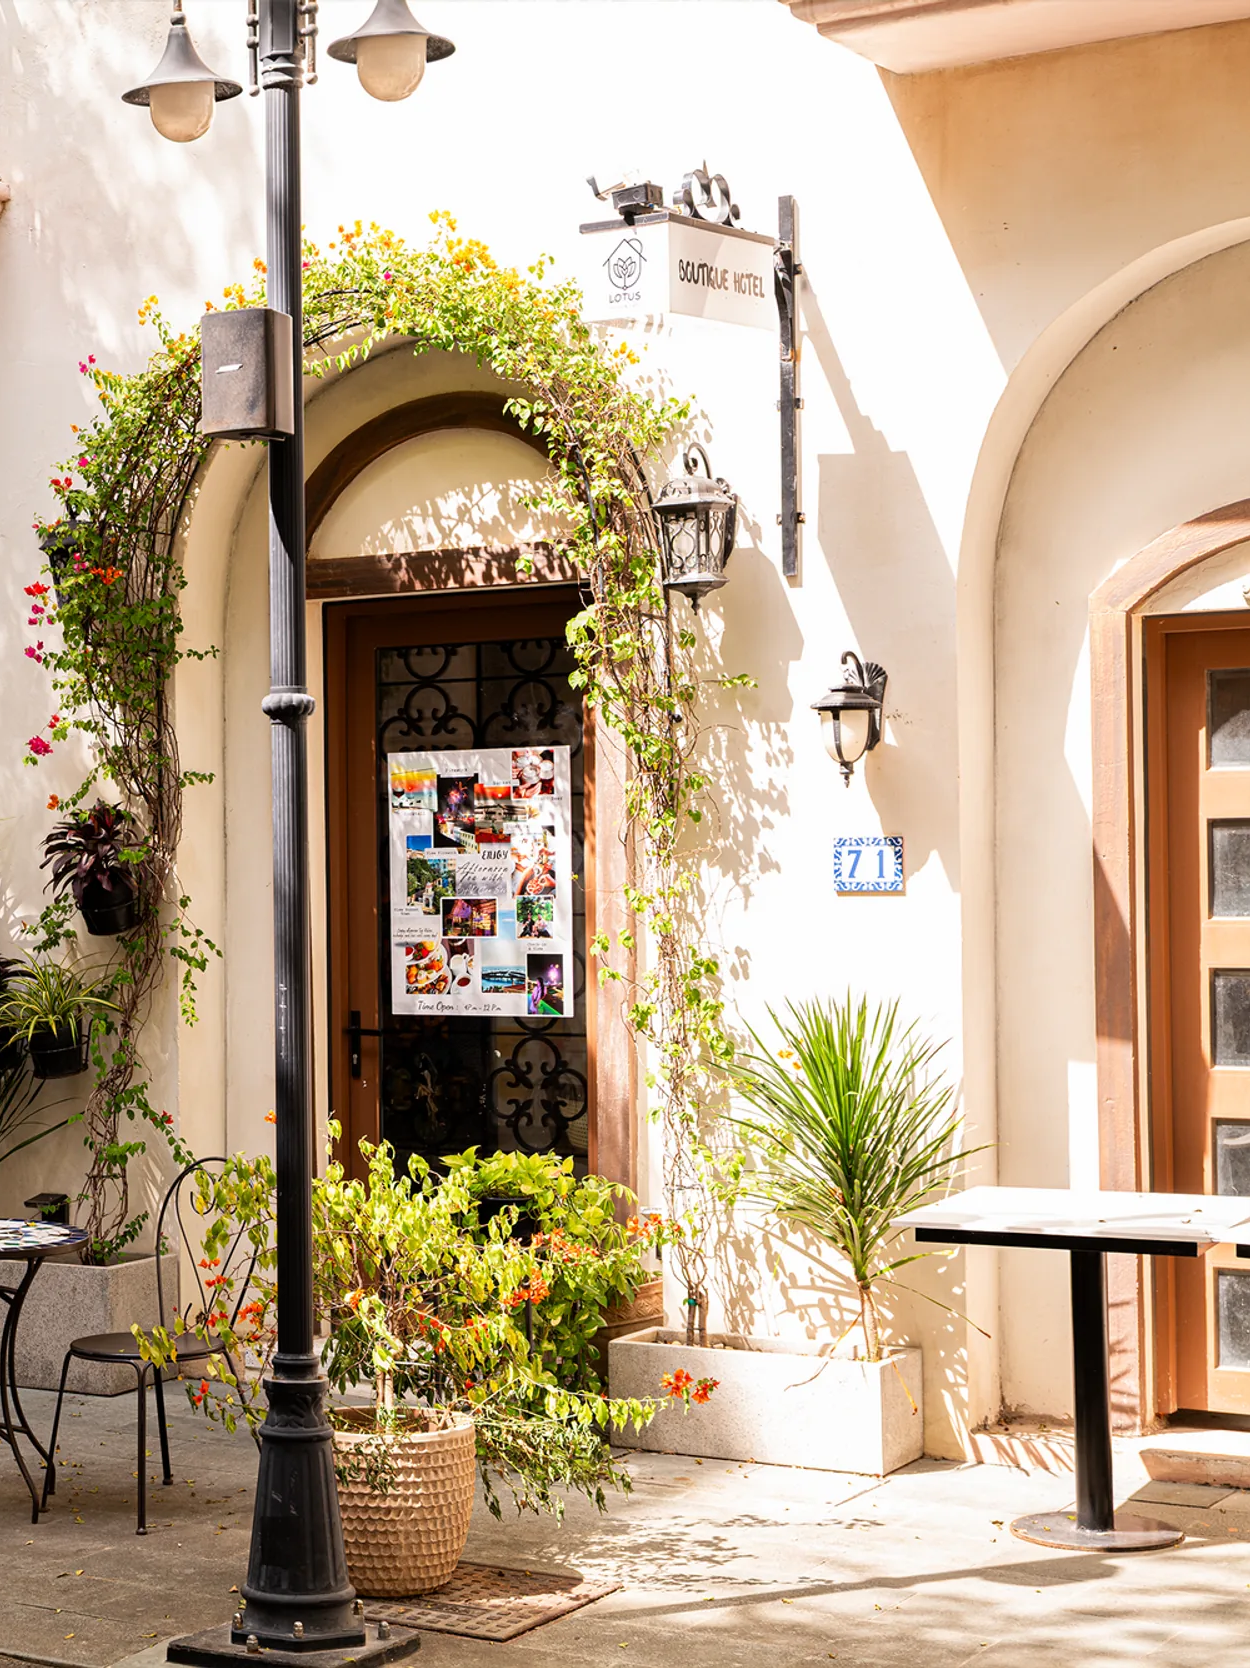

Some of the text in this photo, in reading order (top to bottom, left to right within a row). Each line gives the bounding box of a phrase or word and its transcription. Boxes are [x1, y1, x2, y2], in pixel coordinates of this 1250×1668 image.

[678, 258, 765, 299] BOUTIQUE HOTEL
[609, 291, 641, 304] LOTUS
[481, 850, 509, 860] ENJOY
[848, 849, 886, 879] 71
[417, 1000, 434, 1010] Time
[436, 1001, 455, 1012] Open
